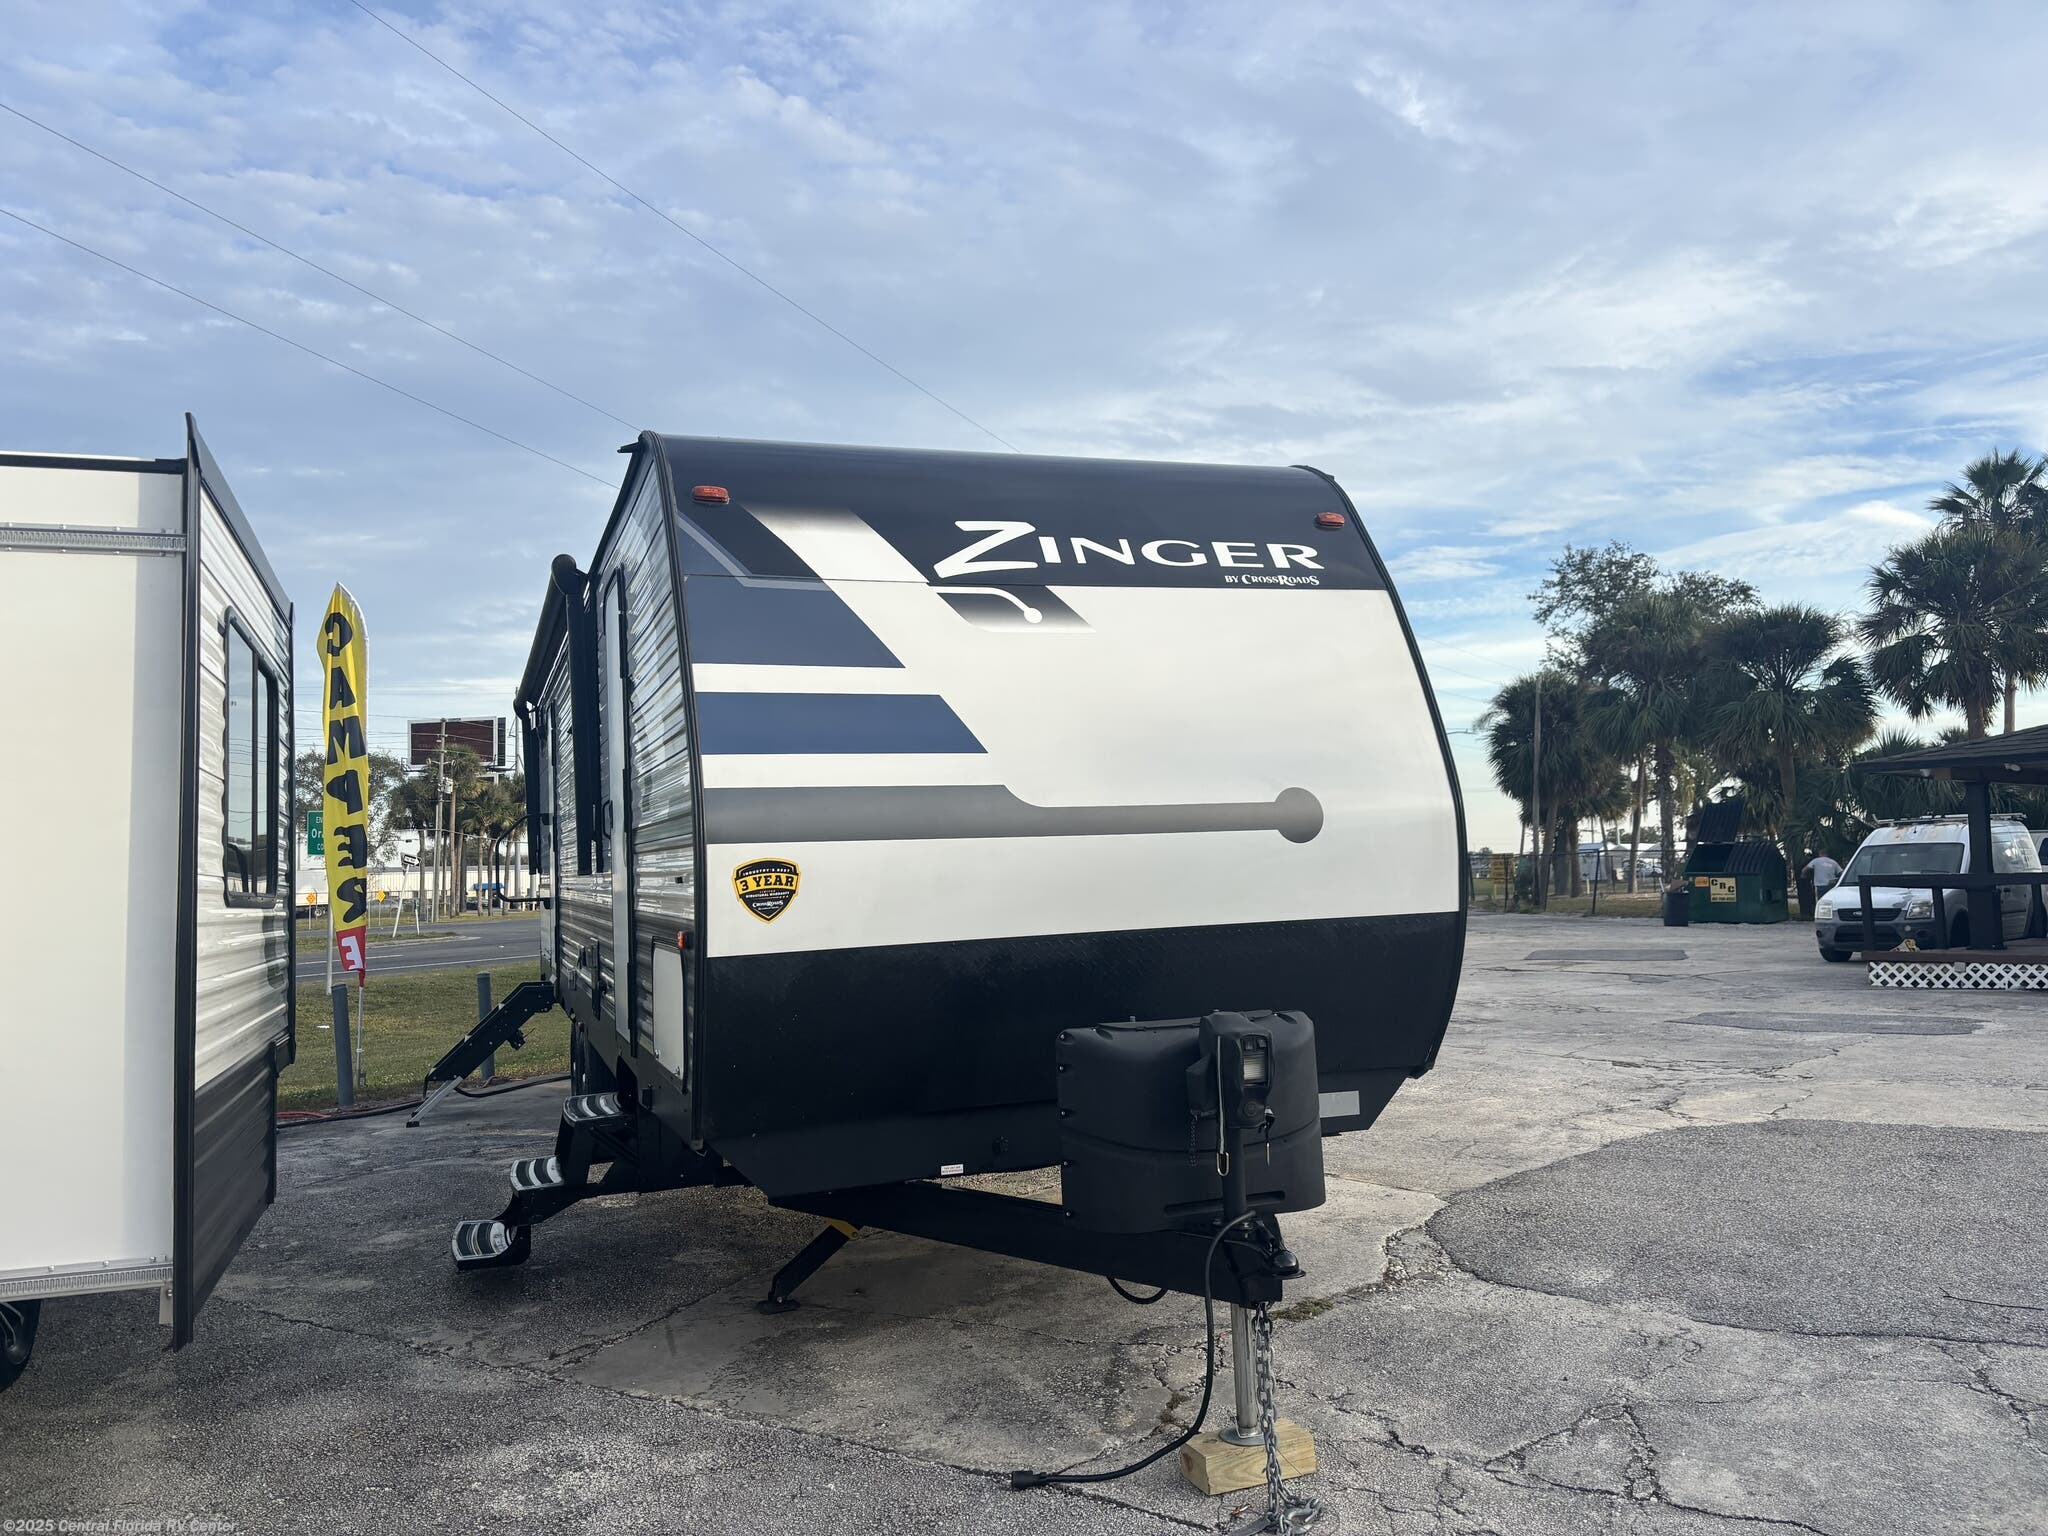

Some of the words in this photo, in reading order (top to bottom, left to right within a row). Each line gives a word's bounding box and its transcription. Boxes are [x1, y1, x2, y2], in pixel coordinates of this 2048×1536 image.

[933, 520, 1325, 578] ZINGER
[1224, 575, 1239, 583] BY
[740, 880, 749, 891] 3
[753, 875, 794, 887] YEAR
